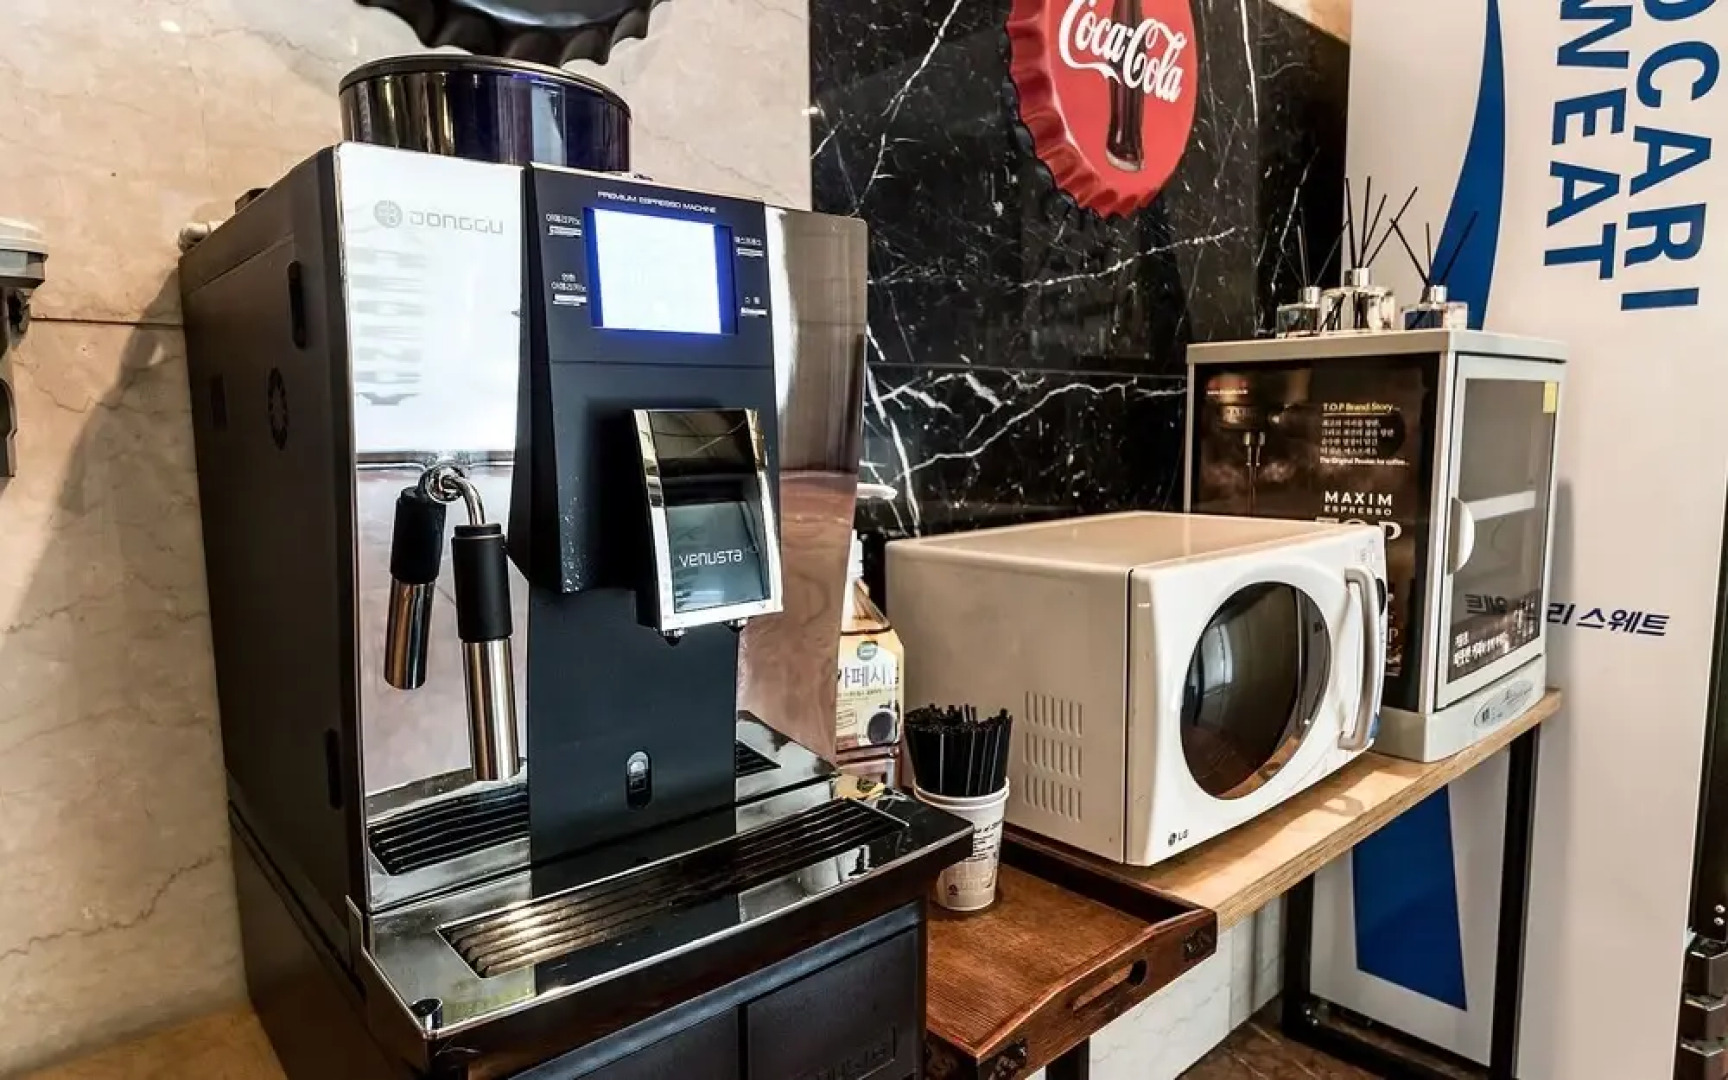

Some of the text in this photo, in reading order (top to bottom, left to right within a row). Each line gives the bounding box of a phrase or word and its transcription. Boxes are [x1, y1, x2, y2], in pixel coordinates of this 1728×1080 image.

[597, 191, 717, 214] PREMIUM ESPRESSO MACHINE
[1324, 490, 1393, 507] MAXIM
[1323, 505, 1393, 516] ESPRESSO
[1576, 608, 1670, 637] 스웨트
[1178, 828, 1189, 841] LG
